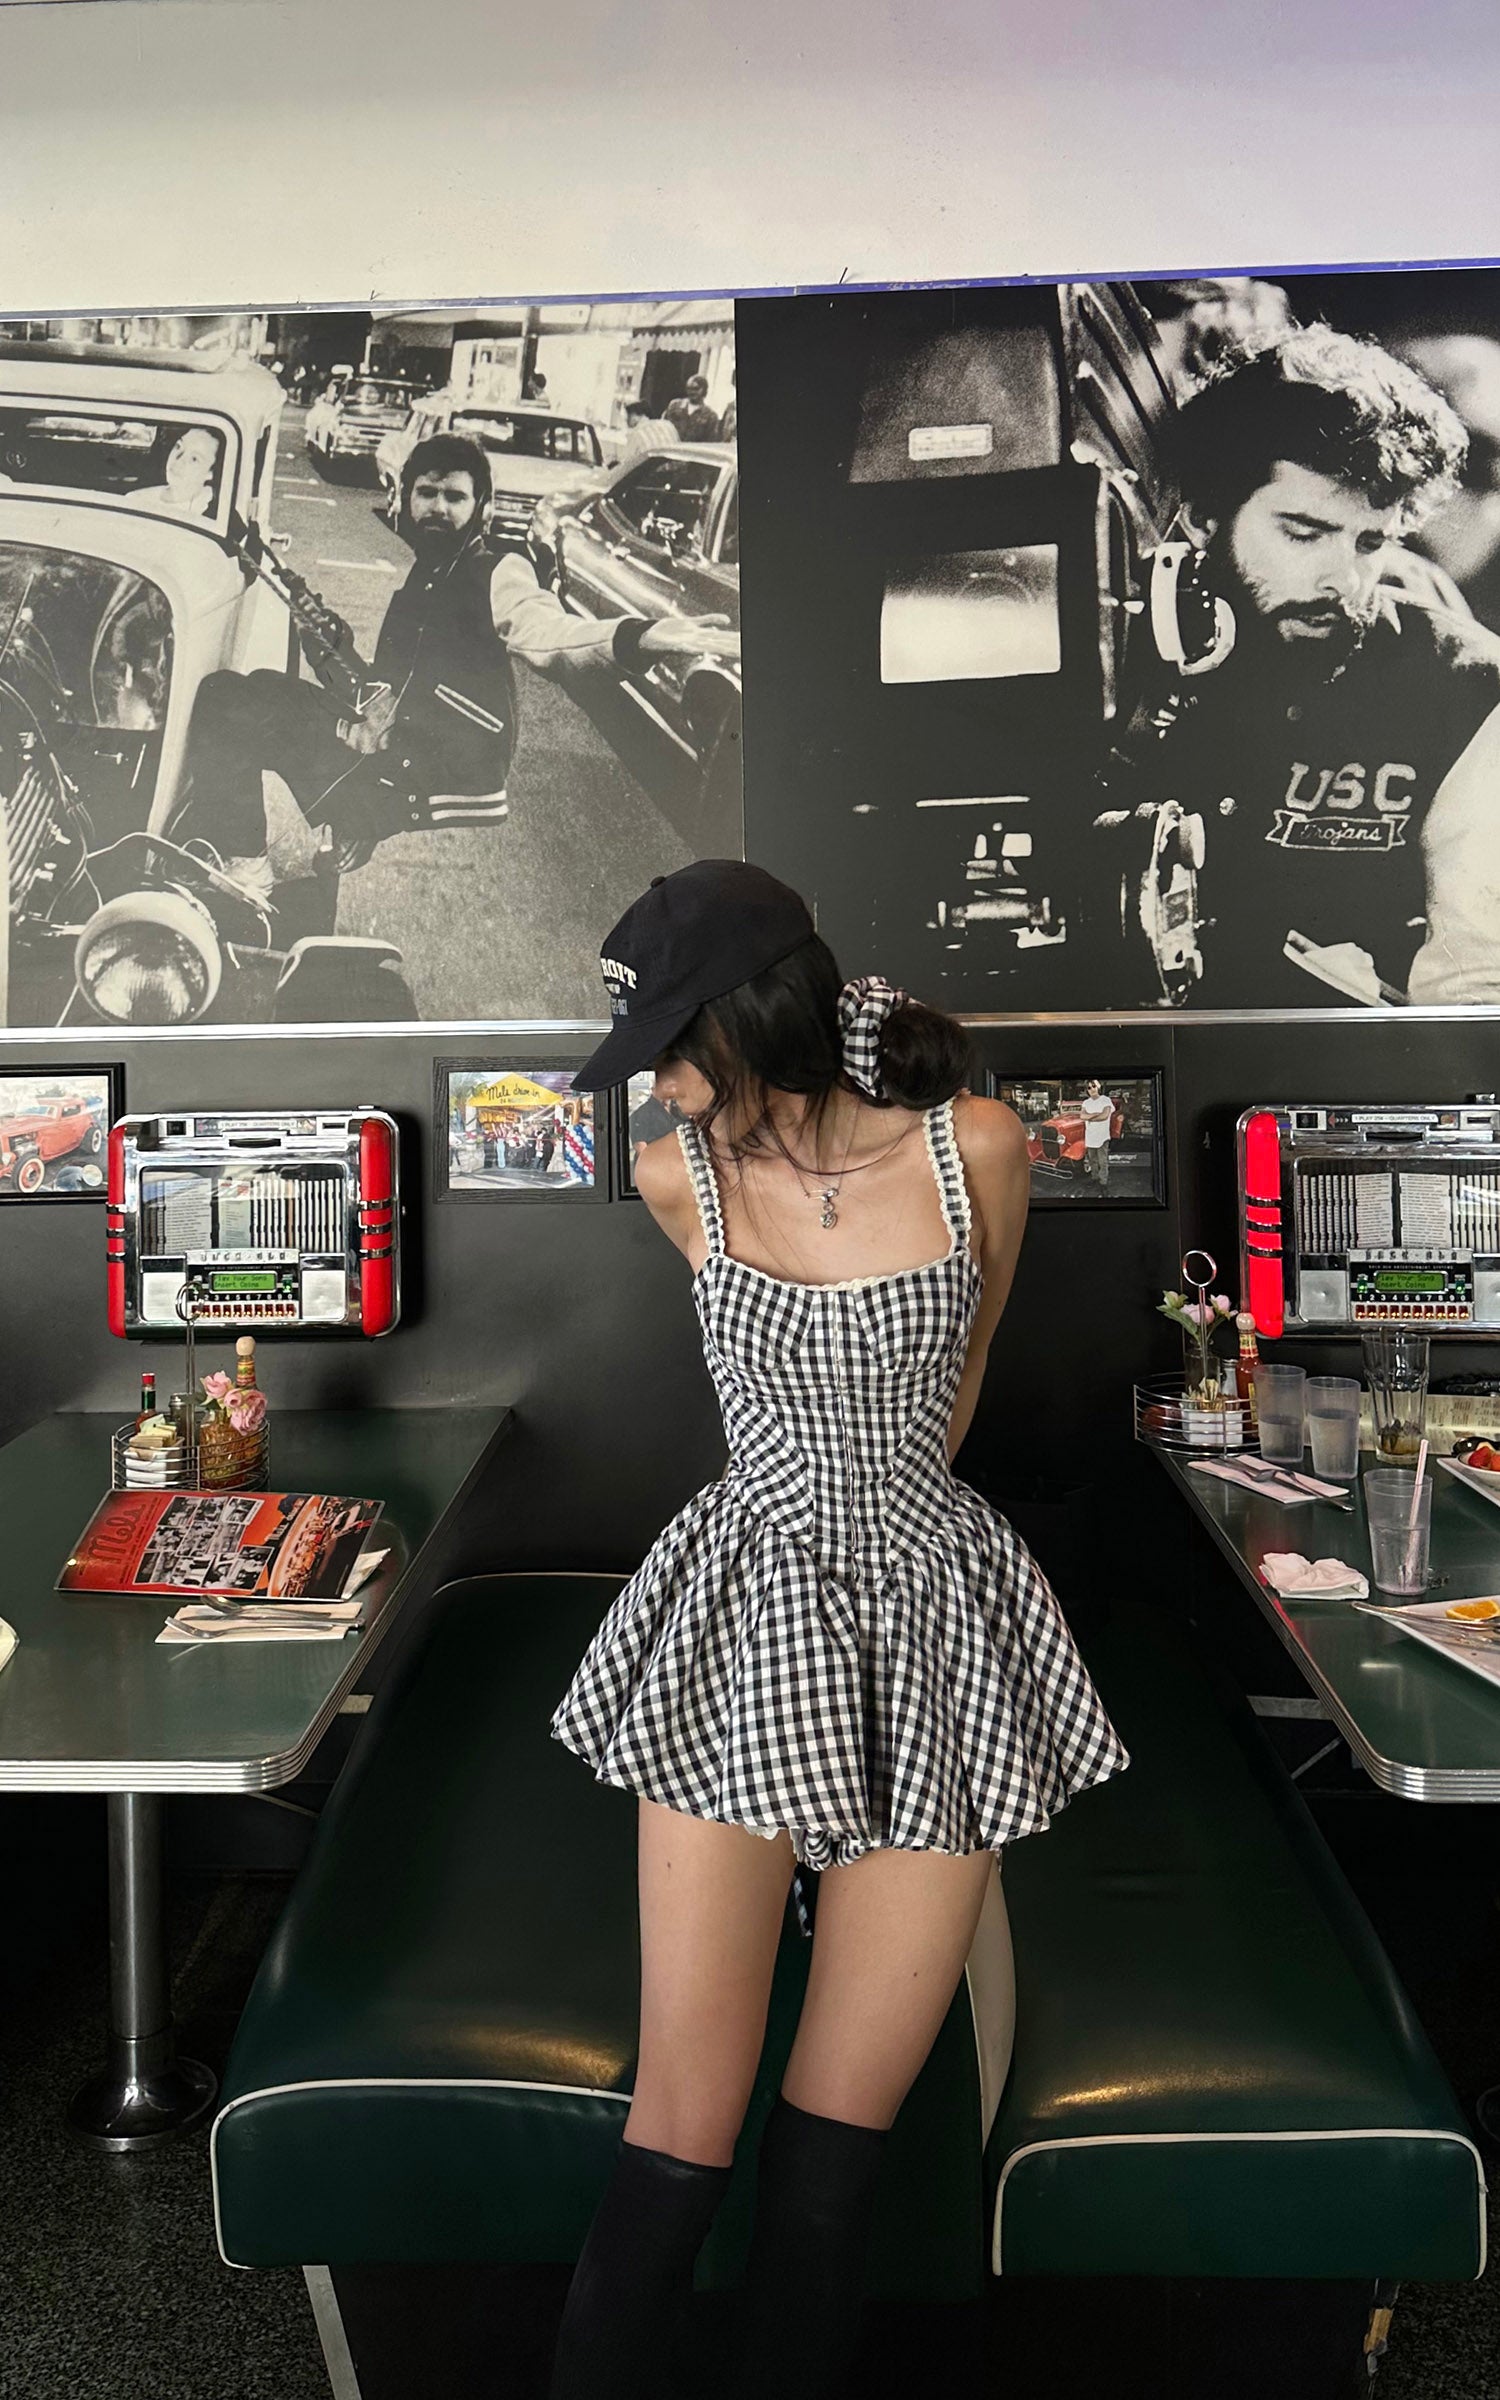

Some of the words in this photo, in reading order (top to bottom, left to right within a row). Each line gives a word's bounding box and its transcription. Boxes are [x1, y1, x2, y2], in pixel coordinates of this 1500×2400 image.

[1285, 762, 1416, 811] USC
[1301, 822, 1383, 845] Trojans
[88, 1504, 146, 1564] Mels
